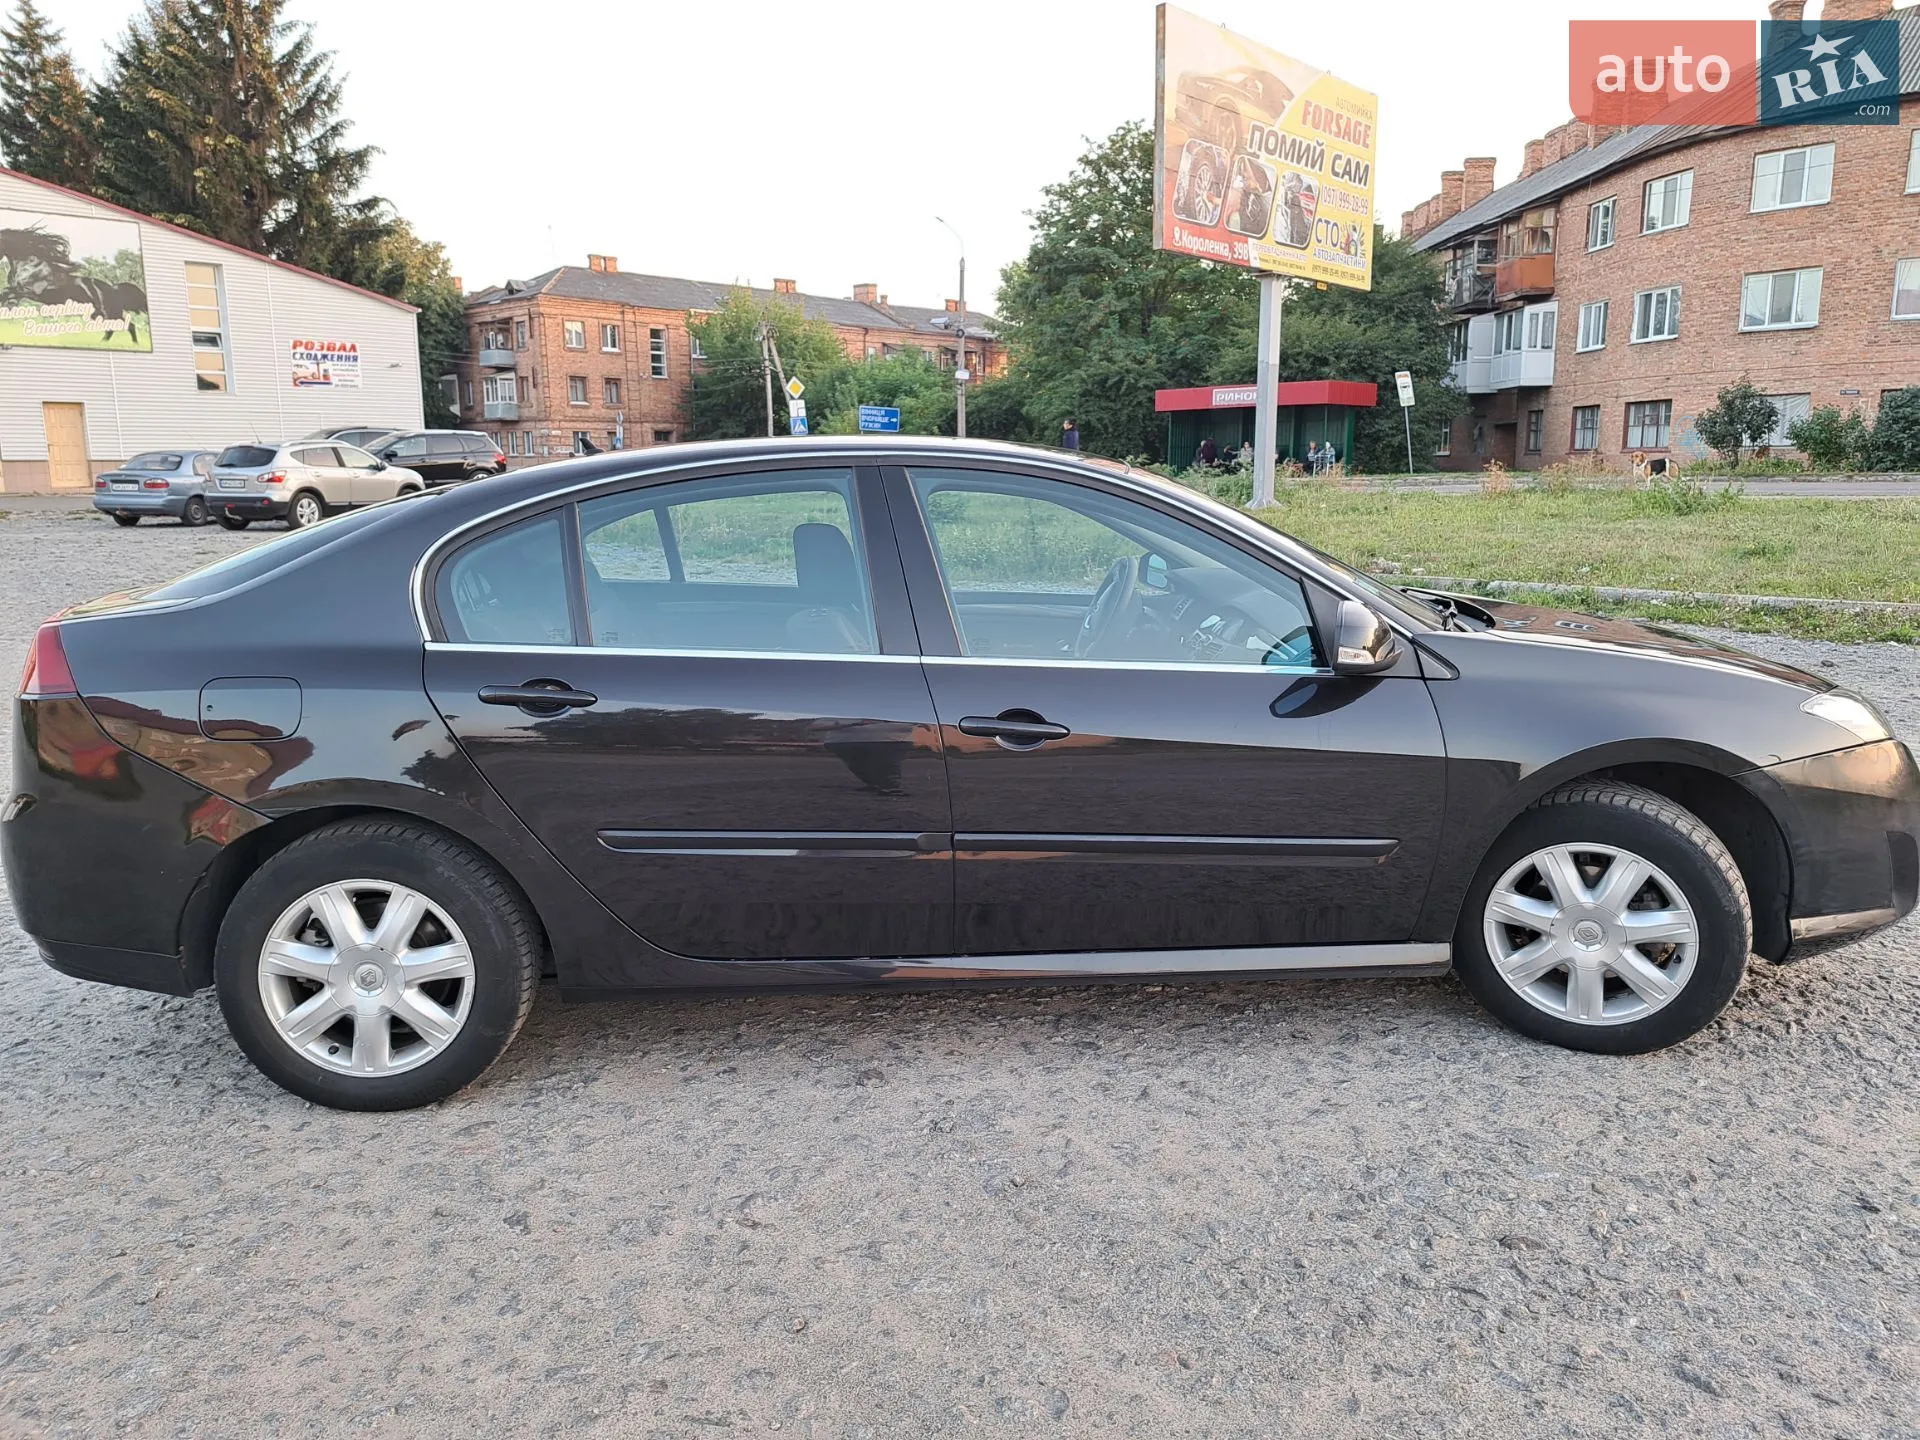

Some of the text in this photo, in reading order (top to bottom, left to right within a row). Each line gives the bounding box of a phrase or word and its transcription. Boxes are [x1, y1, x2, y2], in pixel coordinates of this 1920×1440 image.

[1302, 100, 1372, 149] FORSAGE
[1248, 123, 1370, 187] ПОМИЙ САМ
[1181, 228, 1233, 261] Короленка,
[1315, 217, 1340, 248] СТО
[1313, 248, 1366, 269] АВТОЗАПЧАСТИНИ
[292, 340, 358, 353] РОЗВАЛ
[292, 351, 359, 363] СХОДЖЕННЯ
